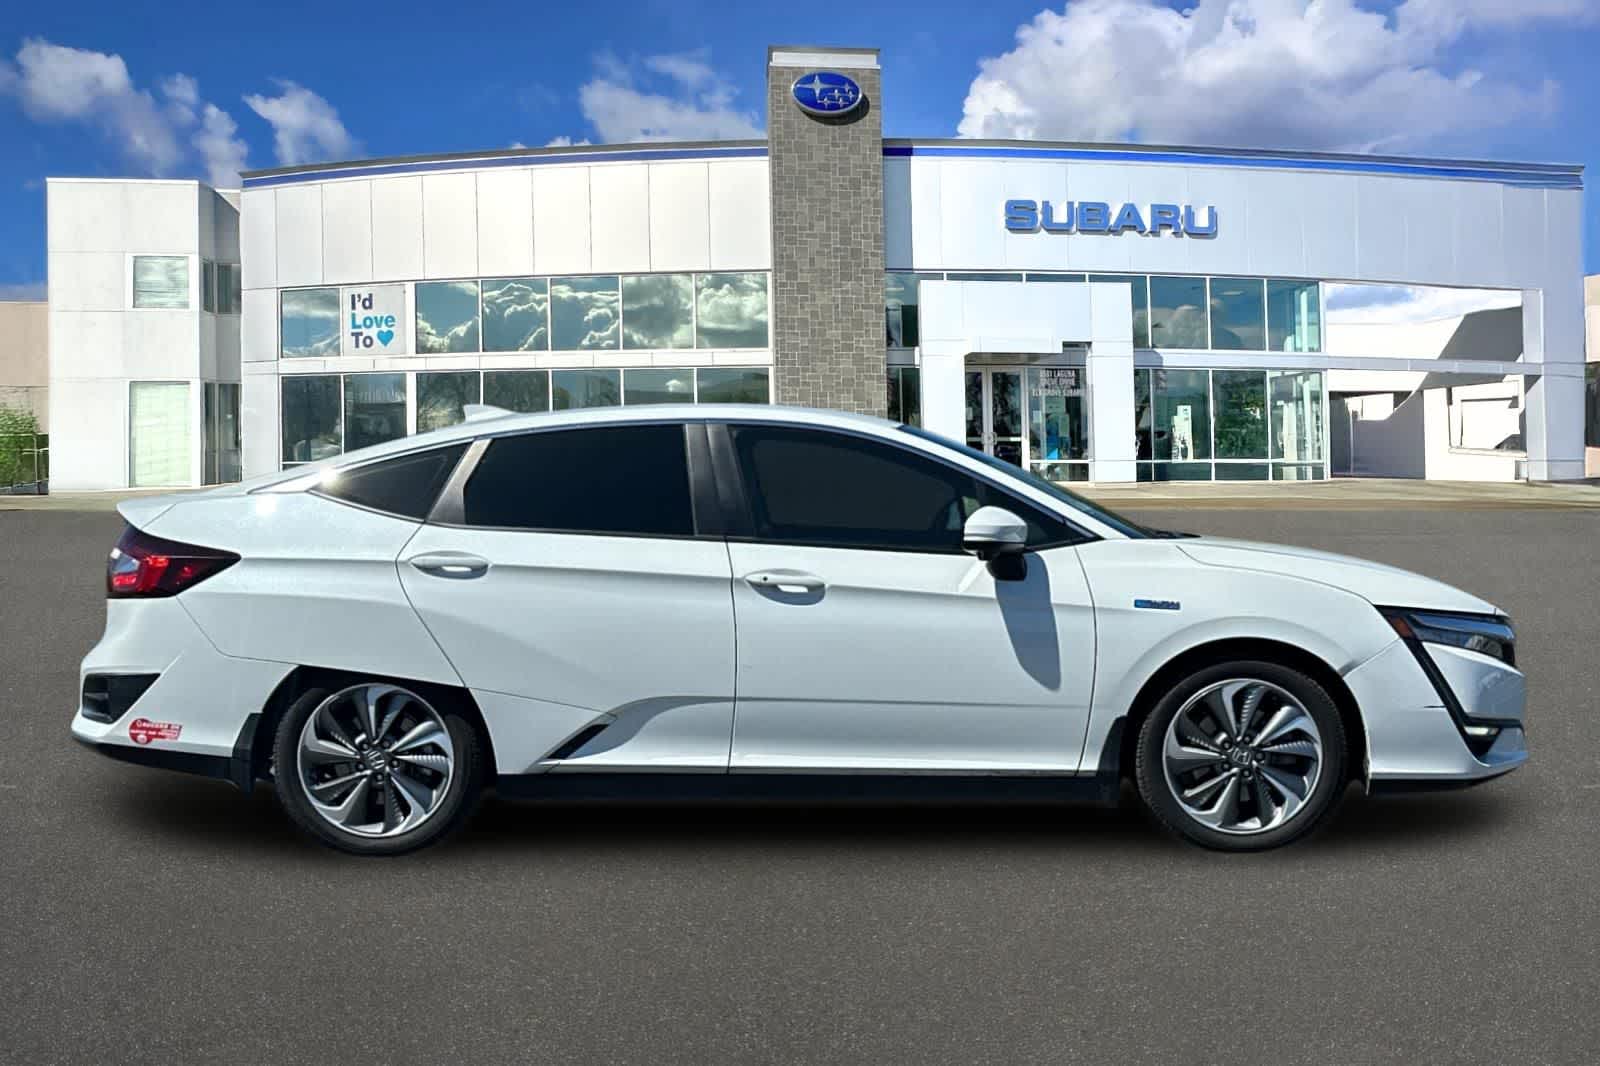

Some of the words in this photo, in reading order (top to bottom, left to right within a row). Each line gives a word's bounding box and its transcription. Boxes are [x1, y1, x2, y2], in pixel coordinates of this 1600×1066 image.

[1005, 200, 1217, 238] SUBARU
[351, 293, 373, 310] I'd
[351, 312, 395, 329] Love
[351, 332, 373, 348] To
